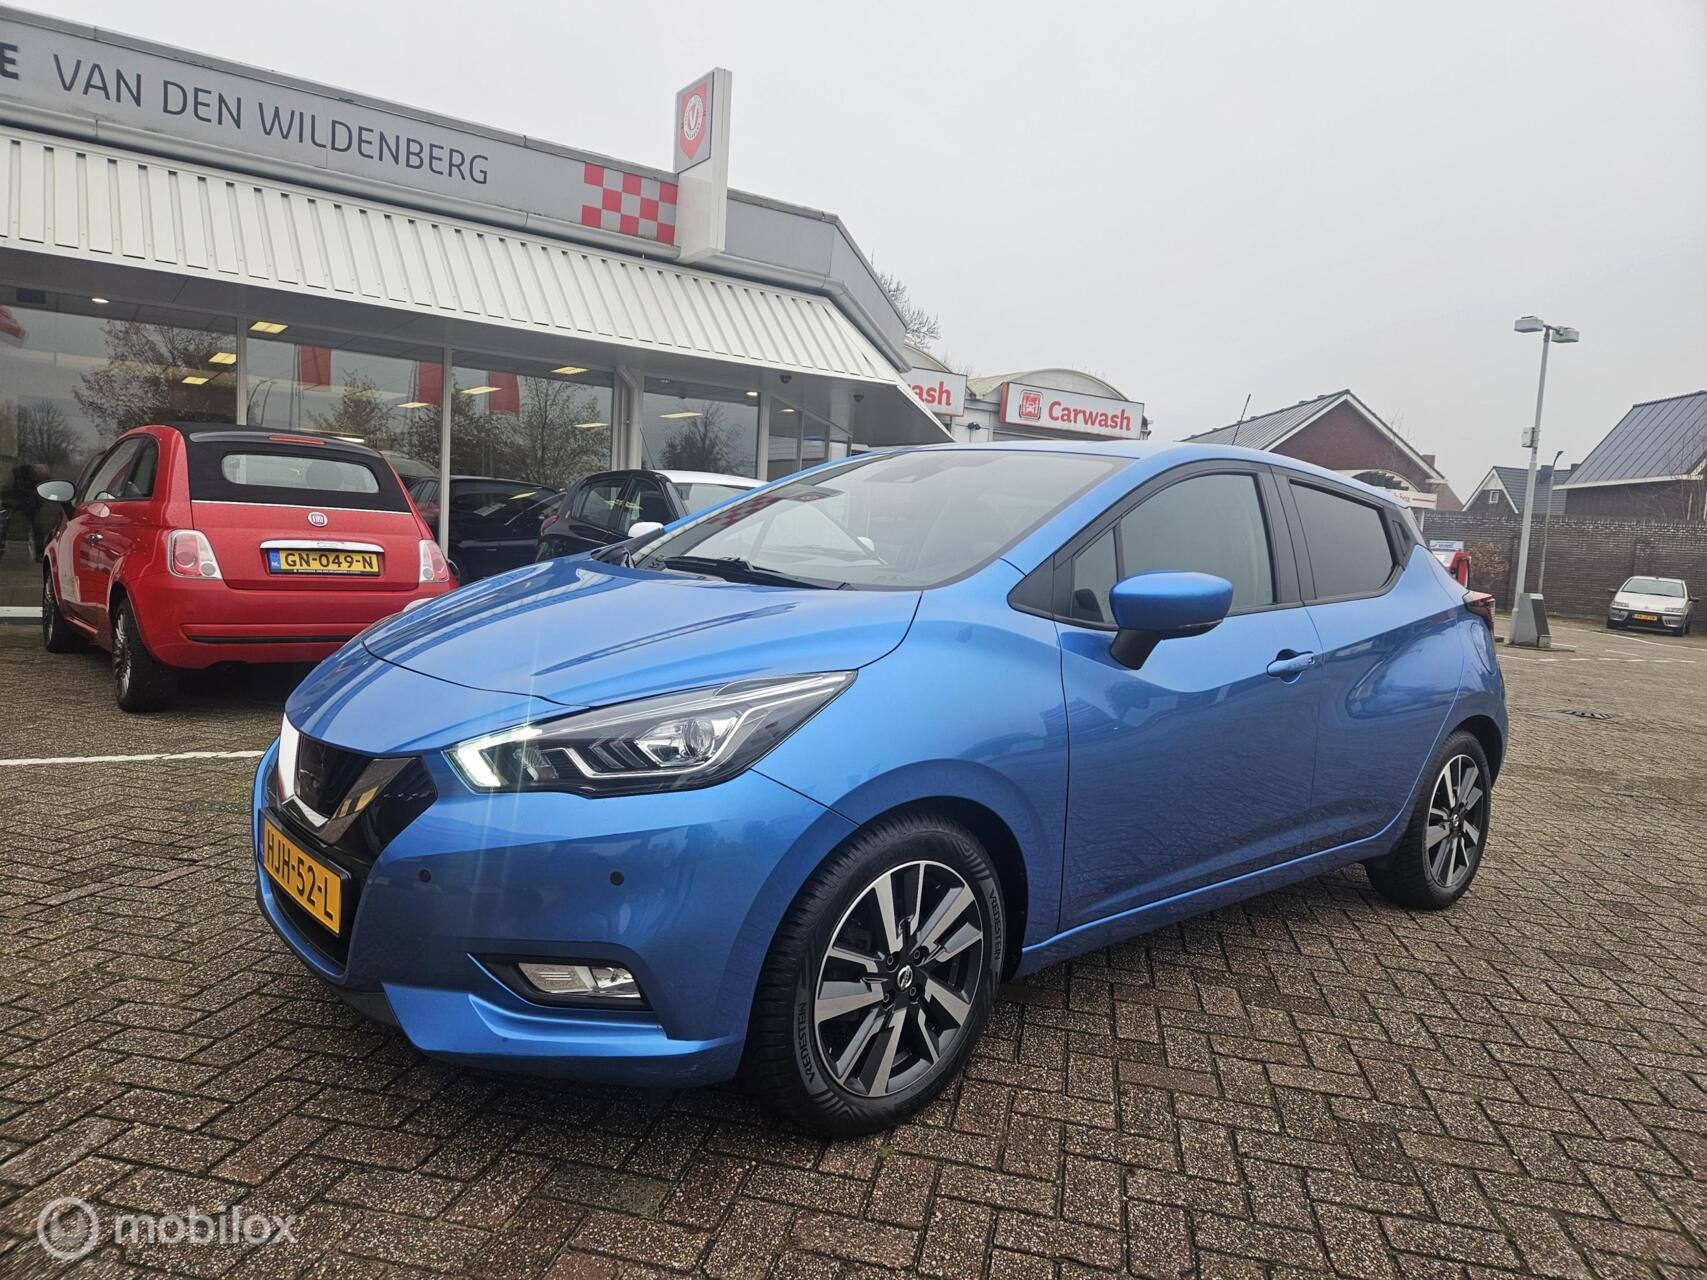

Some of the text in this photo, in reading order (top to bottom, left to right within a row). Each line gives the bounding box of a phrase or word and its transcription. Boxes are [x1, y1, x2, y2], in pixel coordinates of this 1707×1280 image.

[53, 53, 141, 107] VAN
[163, 80, 241, 129] DEN
[258, 102, 488, 185] WILDENBERG
[907, 381, 951, 406] ash
[1048, 400, 1132, 432] Carwash
[284, 552, 374, 569] GN-049-N
[267, 828, 334, 922] HJH-52-L
